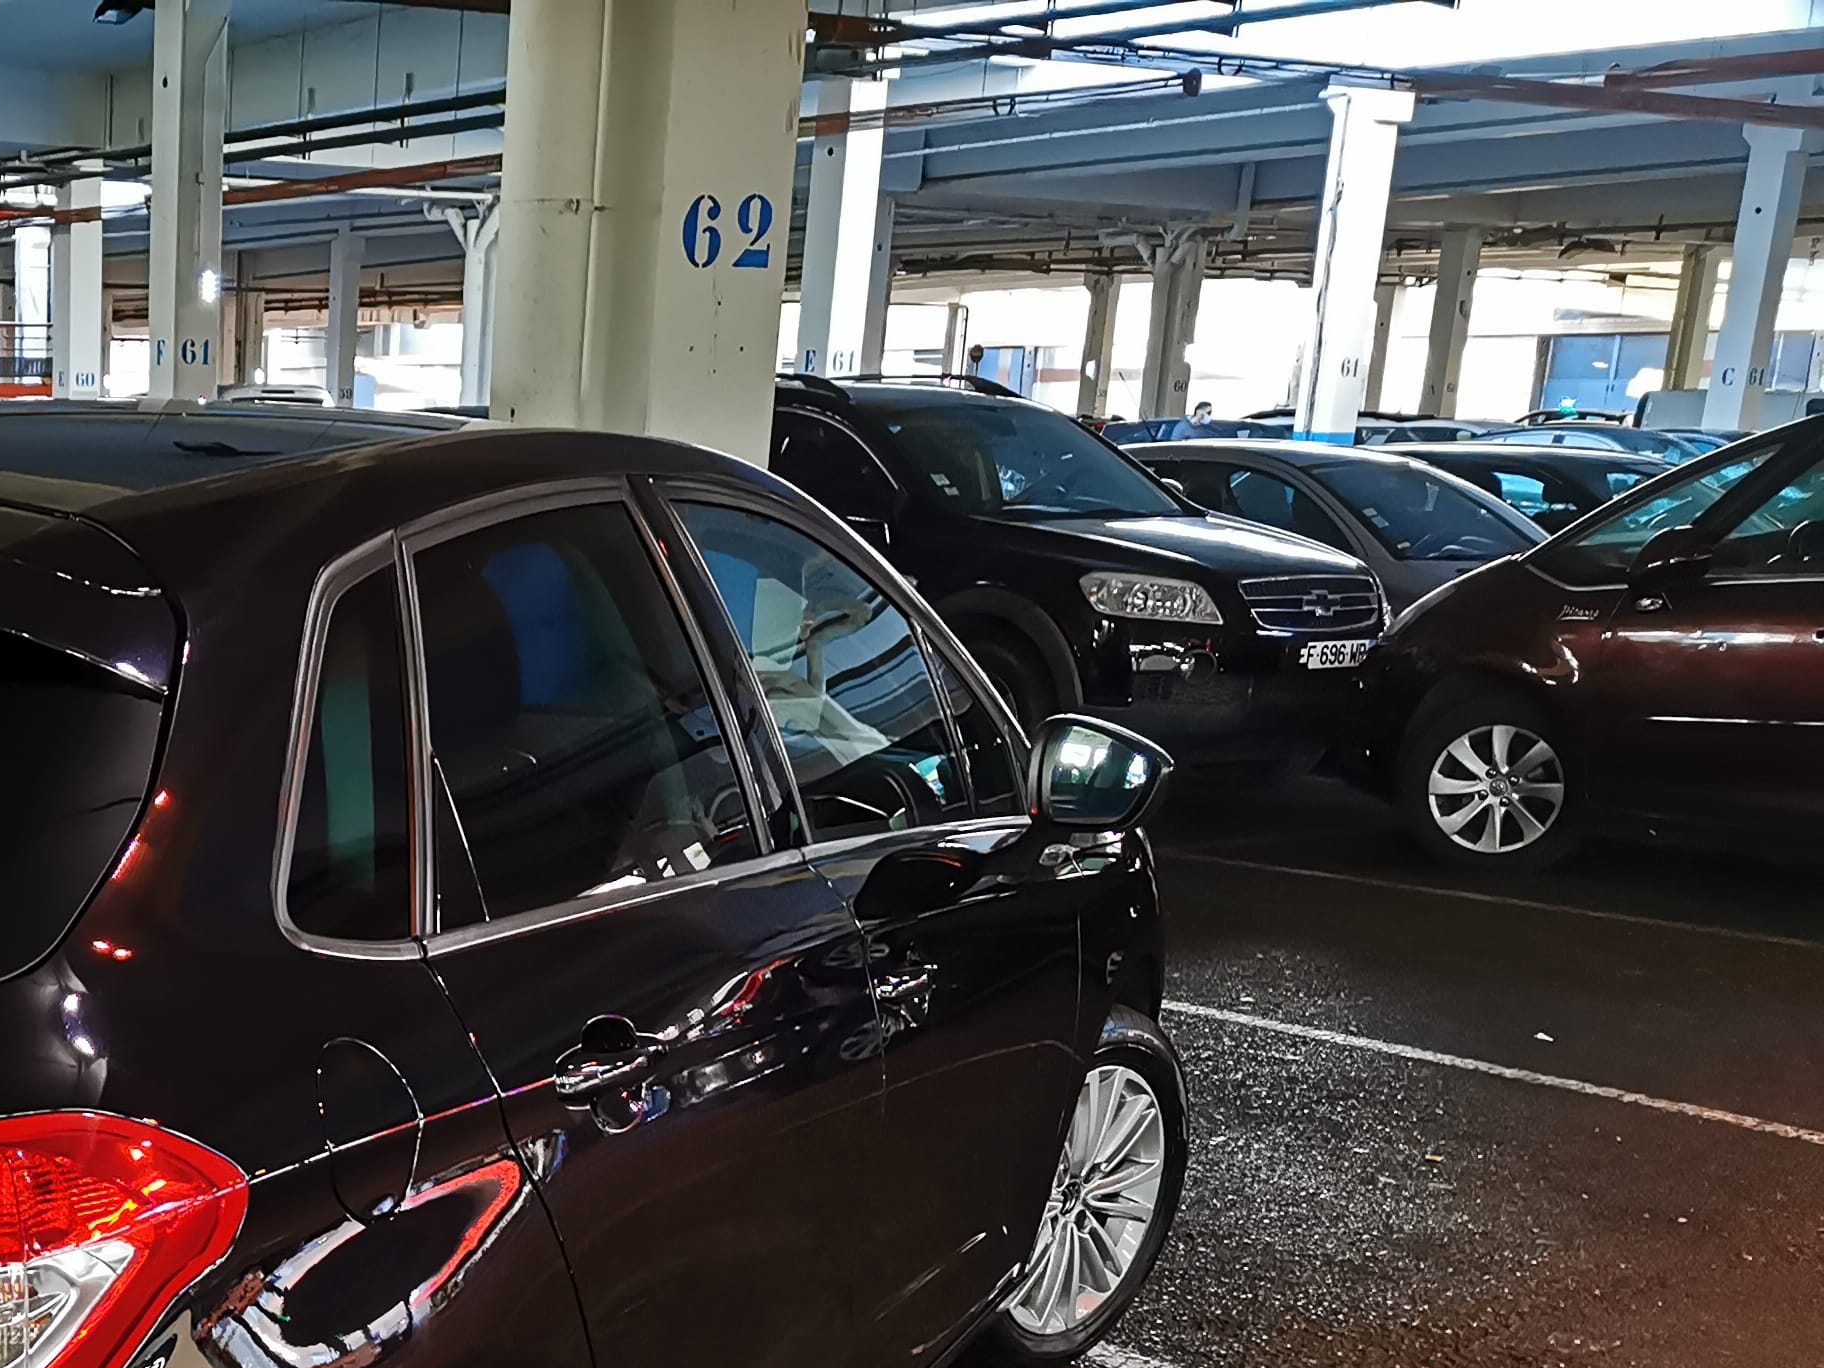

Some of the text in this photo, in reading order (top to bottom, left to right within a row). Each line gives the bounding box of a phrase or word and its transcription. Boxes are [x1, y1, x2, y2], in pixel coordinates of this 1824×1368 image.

[682, 193, 773, 269] 62
[156, 338, 167, 366] F
[181, 338, 209, 366] 61
[805, 350, 816, 372] E
[833, 350, 854, 373] 61
[1341, 357, 1359, 378] 61
[1721, 367, 1735, 386] C
[1749, 367, 1765, 386] 61
[76, 372, 95, 388] 60
